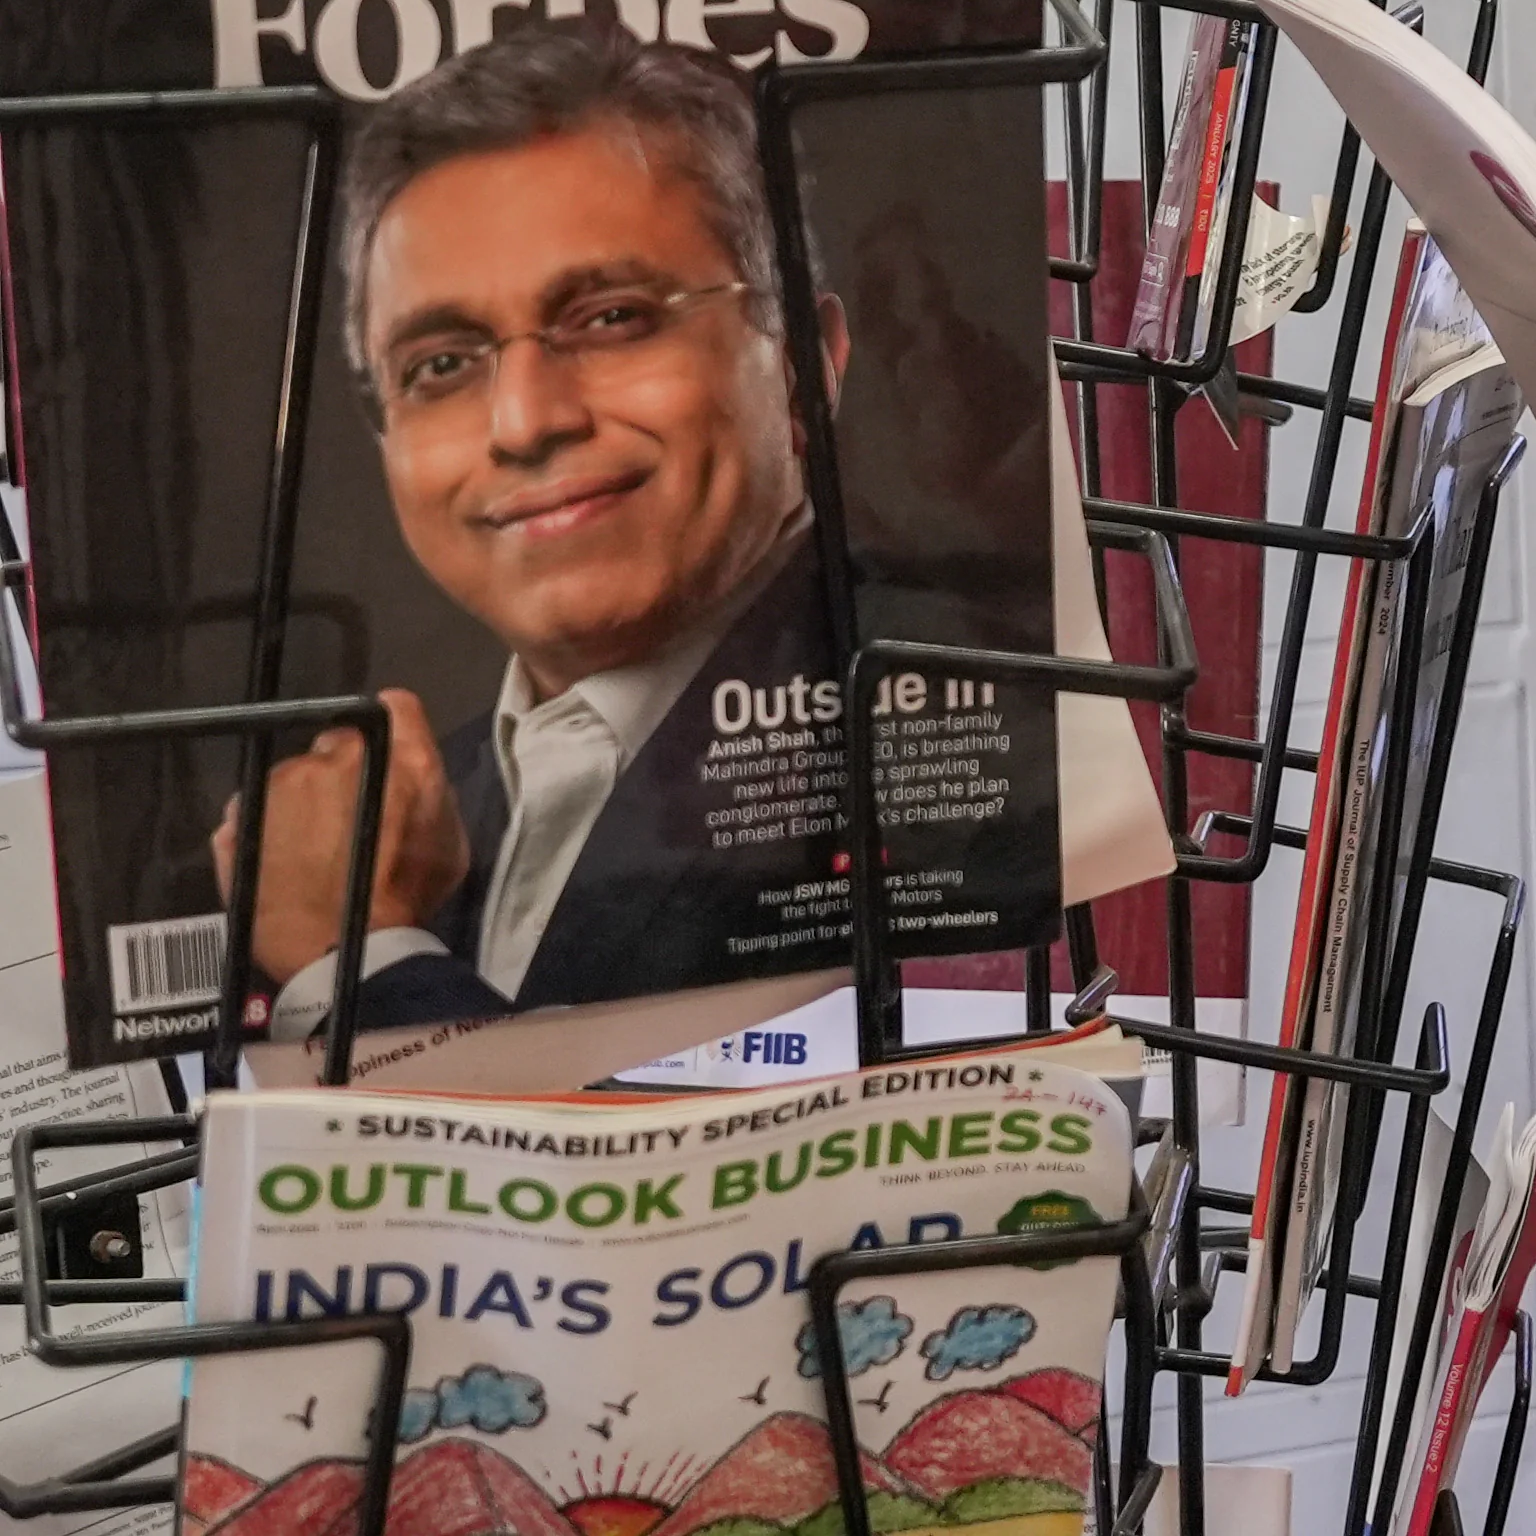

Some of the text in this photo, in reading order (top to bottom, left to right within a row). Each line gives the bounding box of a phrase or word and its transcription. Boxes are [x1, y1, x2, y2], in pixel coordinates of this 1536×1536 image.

[1207, 110, 1226, 160] JANUARY
[1377, 606, 1391, 636] 2024
[703, 756, 790, 782] Mahindra
[903, 738, 920, 758] is
[922, 731, 1012, 758] breathing
[707, 736, 763, 760] Anish
[902, 710, 1004, 736] non-family
[1359, 737, 1371, 763] The
[706, 774, 1011, 829] conglomerate. does he plan
[733, 756, 981, 801] new life into sprawling
[1354, 766, 1368, 788] IUP
[713, 796, 1006, 848] to meet Elon challenge?
[1347, 788, 1365, 834] Journal
[758, 888, 791, 907] How
[919, 868, 965, 889] taking
[1337, 852, 1356, 897] Supply
[781, 902, 806, 920] the
[890, 887, 944, 907] Motors
[1334, 897, 1348, 936] Chain
[728, 934, 780, 957] Tipping
[781, 928, 817, 950] point
[818, 925, 840, 943] for
[896, 908, 1000, 932] two-wheelers
[1323, 937, 1345, 1014] Management
[742, 1031, 808, 1065] FIIB
[357, 1063, 1016, 1162] SUSTAINABILITY SPECIAL EDITION
[257, 1107, 1093, 1230] OUTLOOK BUSINESS
[1296, 1118, 1318, 1214] www.iupindia.in
[254, 1262, 613, 1337] INDIA'S
[1439, 1361, 1465, 1410] Volume
[1428, 1429, 1447, 1458] Issue
